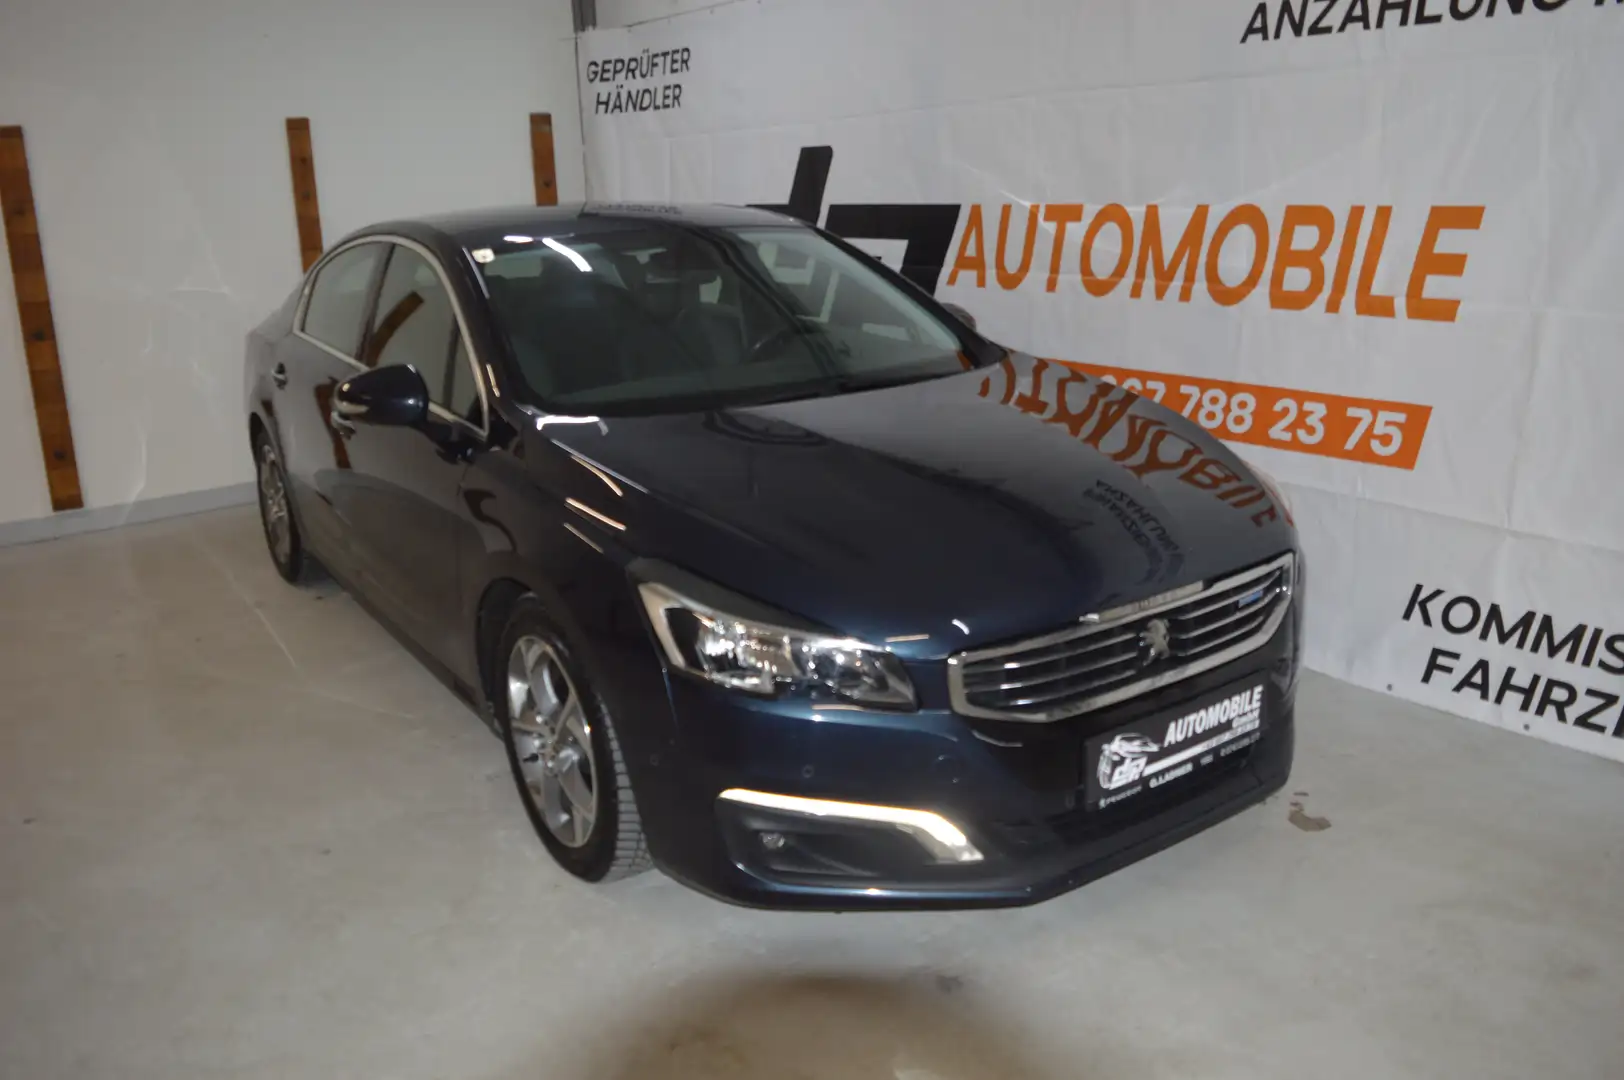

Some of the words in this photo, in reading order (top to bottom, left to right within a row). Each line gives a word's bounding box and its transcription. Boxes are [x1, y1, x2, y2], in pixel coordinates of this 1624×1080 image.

[586, 48, 690, 84] GEPRÜFTER
[595, 84, 682, 114] HÄNDLER
[948, 204, 1485, 322] AUTOMOBILE
[1180, 384, 1257, 434] 788
[1267, 397, 1327, 445] 23
[1343, 407, 1407, 457] 75
[1163, 684, 1264, 748] AUTOMOBILE
